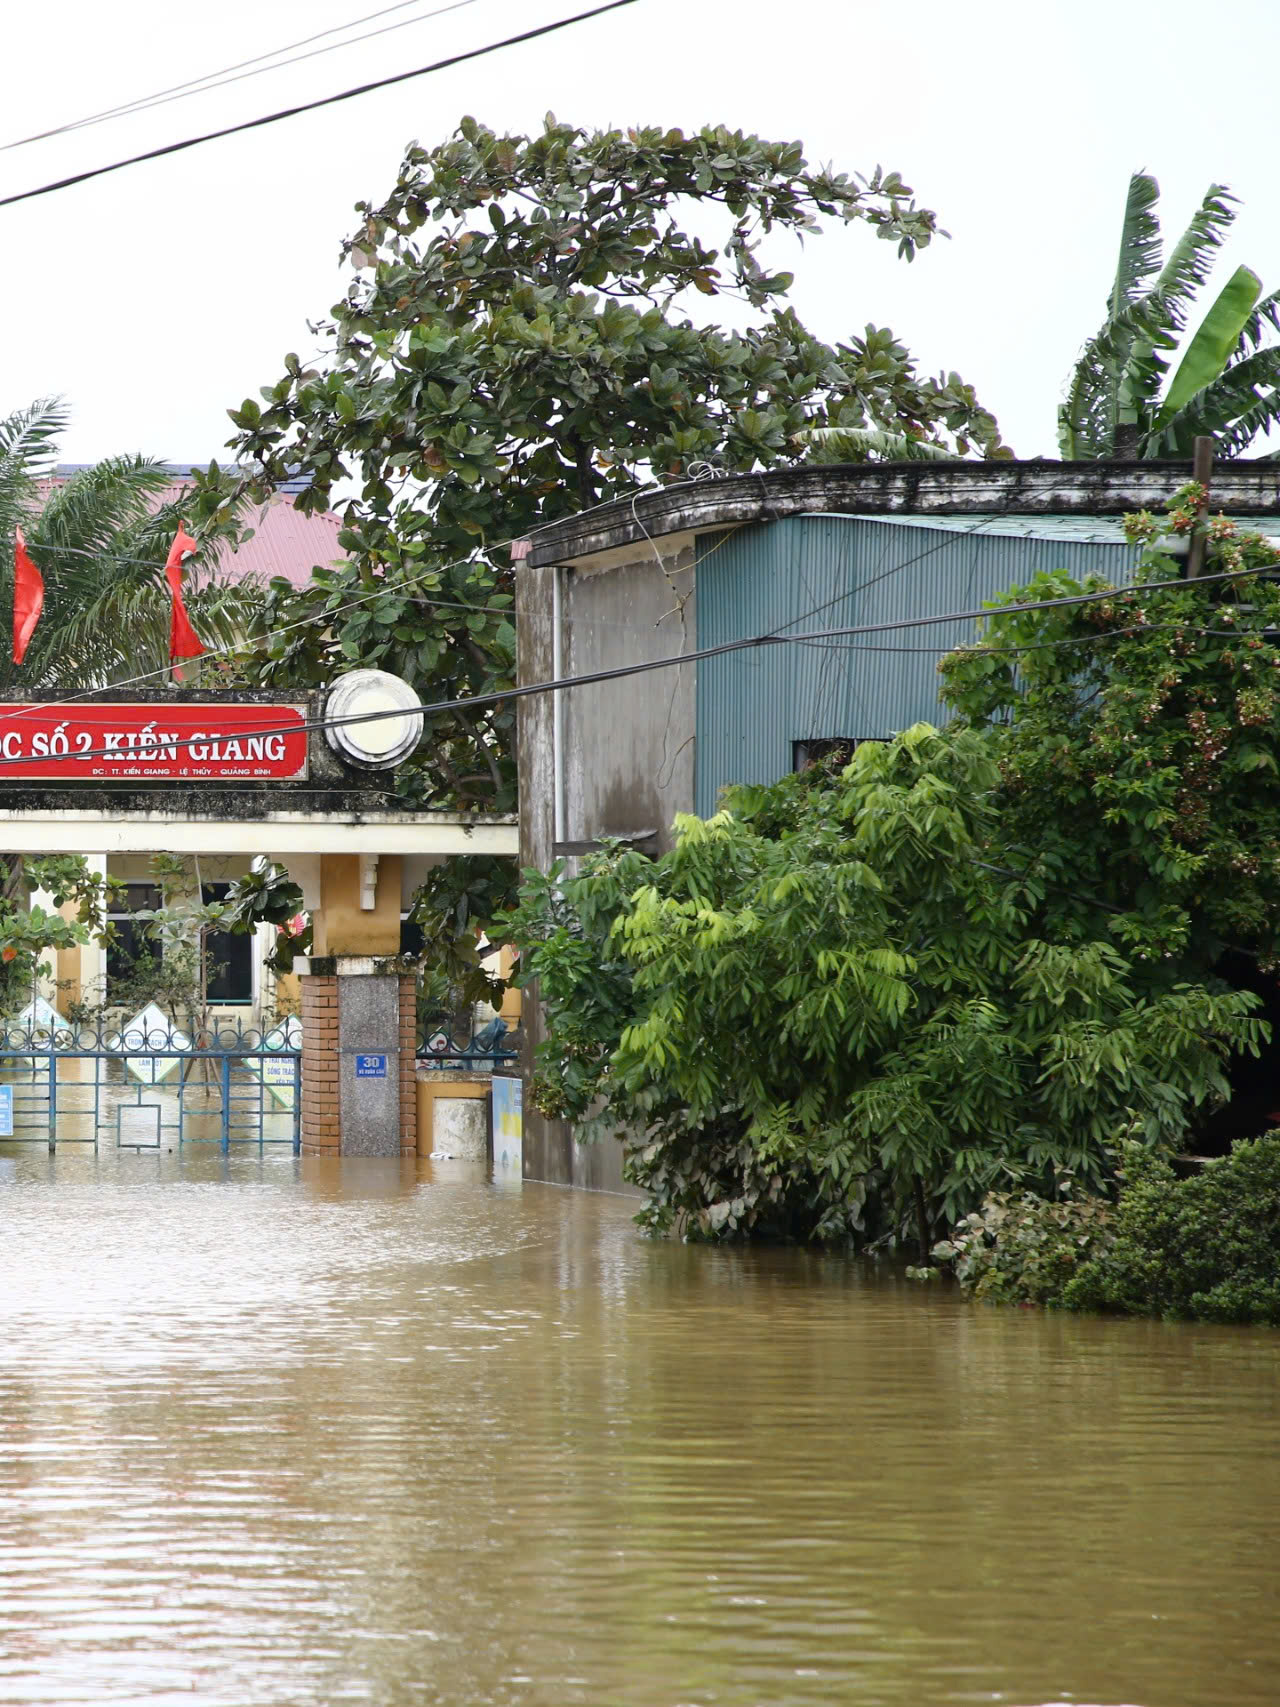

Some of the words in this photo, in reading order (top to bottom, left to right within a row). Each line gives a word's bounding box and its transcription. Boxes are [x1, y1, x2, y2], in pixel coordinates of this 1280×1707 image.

[31, 721, 70, 760] SỐ
[75, 732, 93, 760] 2
[103, 720, 179, 761] KIẾN
[188, 732, 286, 761] GIANG
[363, 1057, 380, 1067] 30
